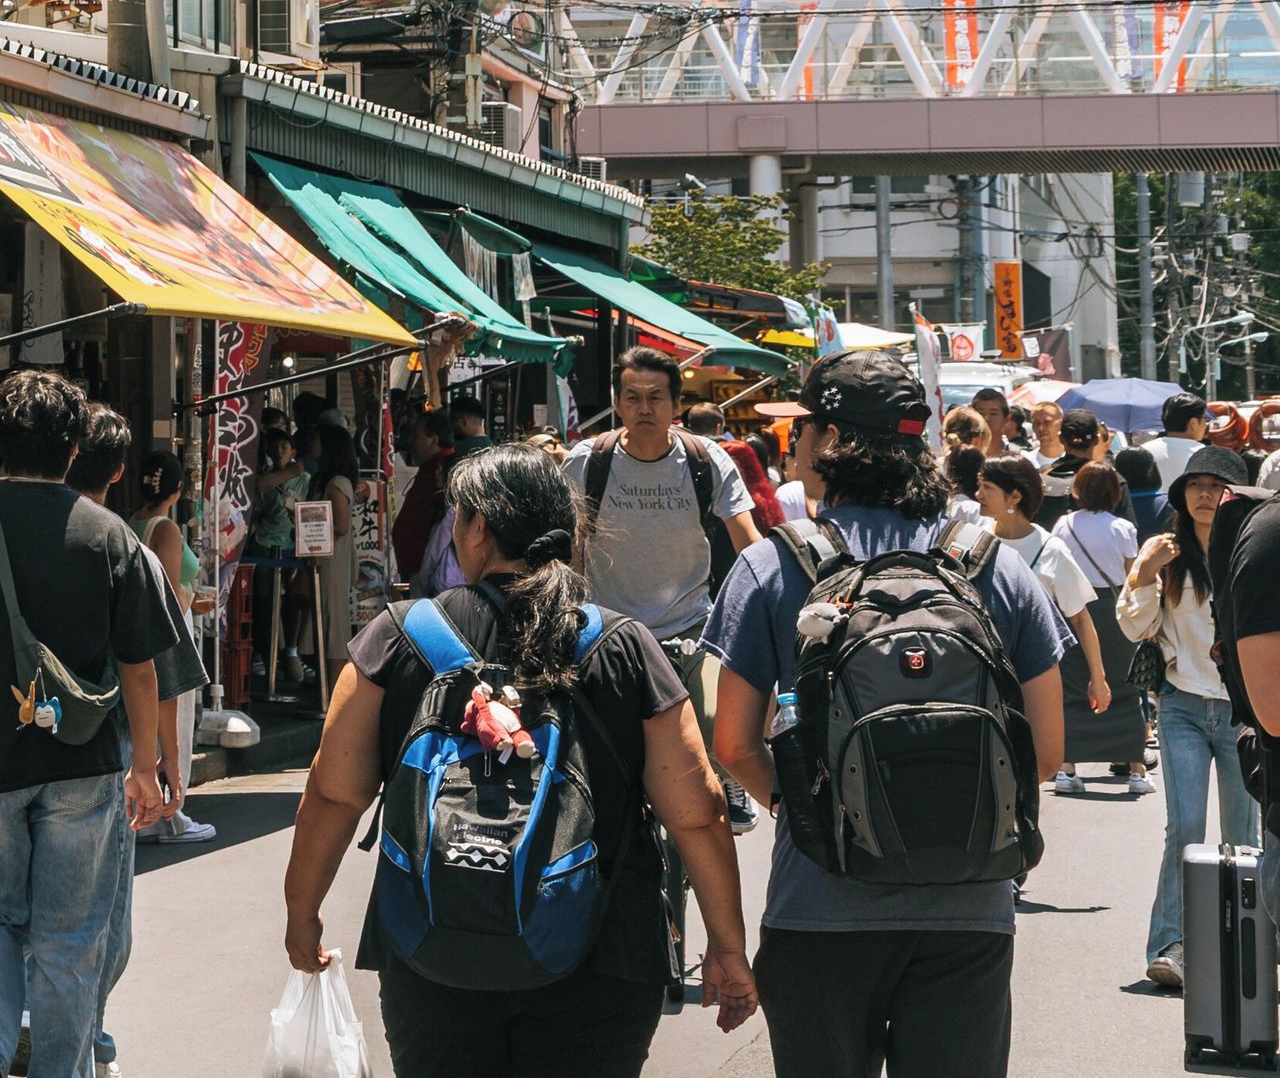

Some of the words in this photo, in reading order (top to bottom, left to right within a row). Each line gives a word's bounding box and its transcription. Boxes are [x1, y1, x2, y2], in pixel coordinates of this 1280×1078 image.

[620, 484, 680, 497] Saturdays
[608, 496, 633, 509] New
[638, 498, 665, 510] York
[667, 496, 691, 510] City
[453, 823, 508, 838] Hawaiian
[455, 831, 502, 845] Electric
